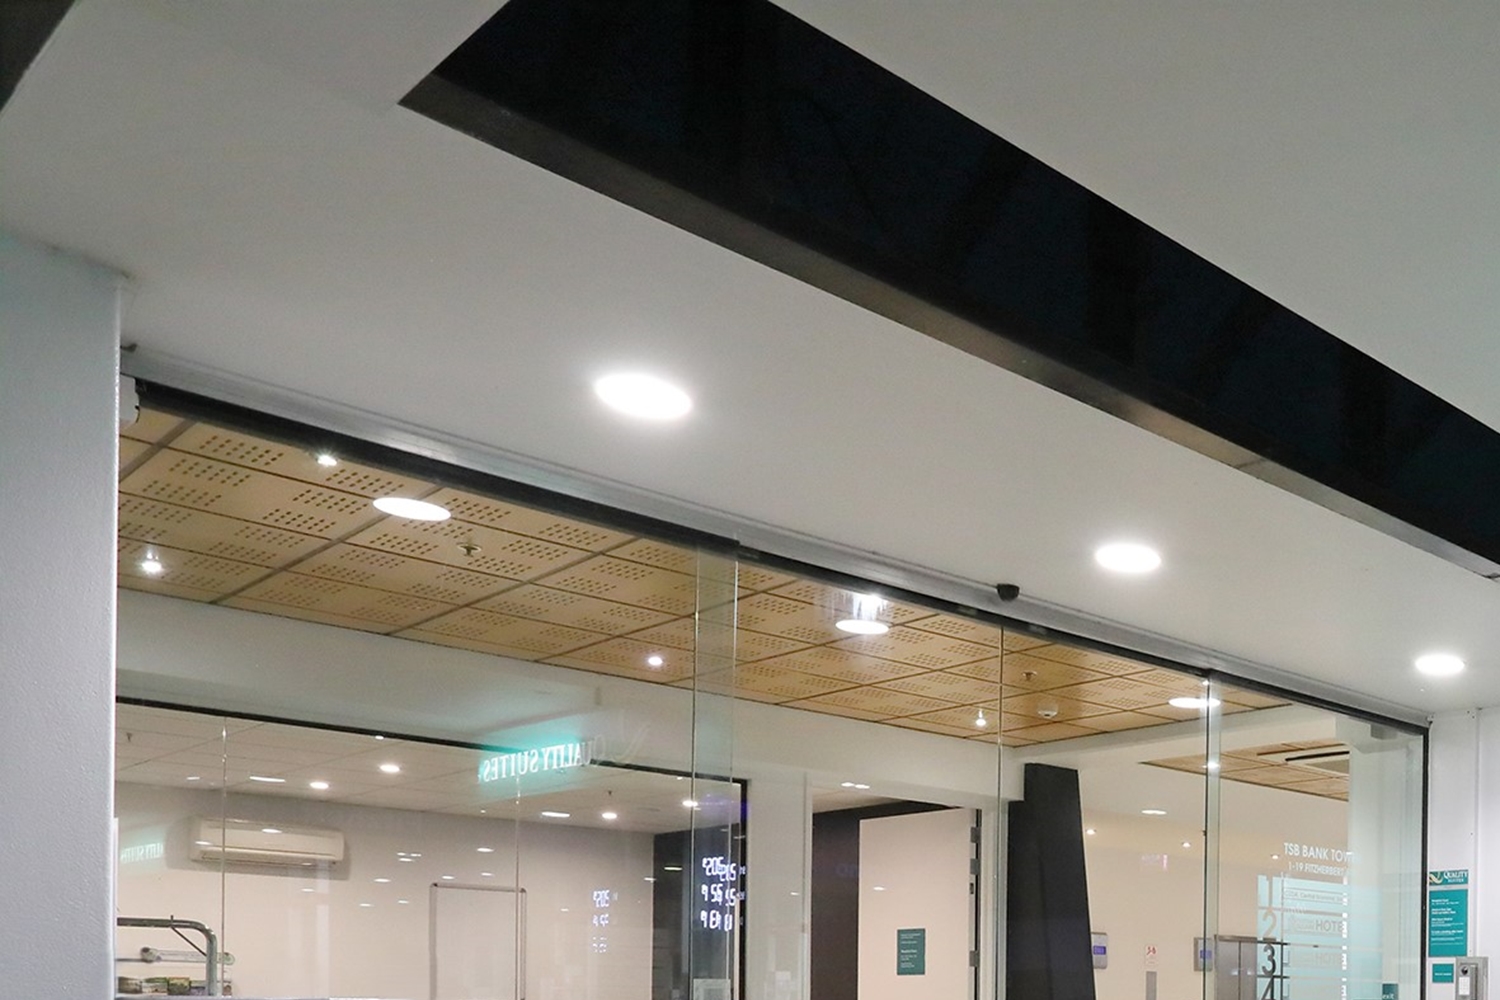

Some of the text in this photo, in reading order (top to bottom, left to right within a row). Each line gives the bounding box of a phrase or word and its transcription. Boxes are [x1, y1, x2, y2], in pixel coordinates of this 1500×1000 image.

[1284, 842, 1300, 857] TSB
[1302, 844, 1329, 861] BANK
[1261, 943, 1276, 977] 3
